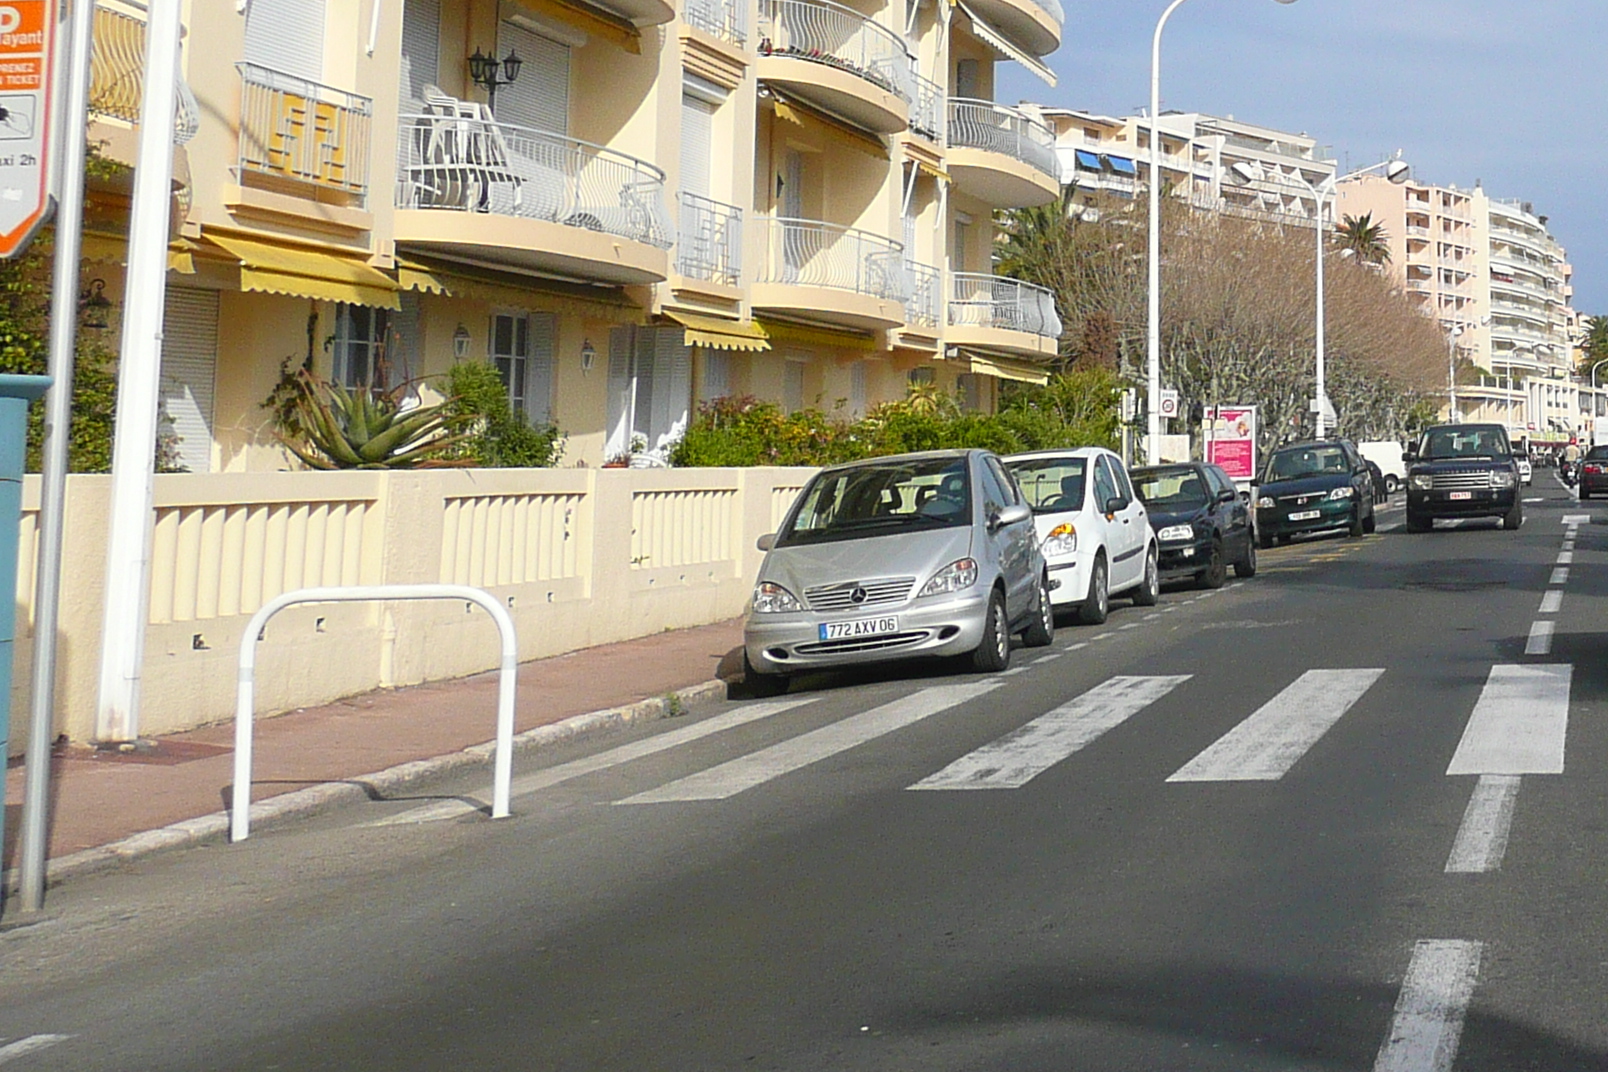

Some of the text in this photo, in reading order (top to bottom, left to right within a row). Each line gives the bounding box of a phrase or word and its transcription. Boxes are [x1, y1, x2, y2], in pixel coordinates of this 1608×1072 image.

[0, 29, 43, 48] ayant
[0, 63, 35, 73] RENEZ
[20, 153, 37, 166] 2h
[829, 618, 895, 637] 772 AXV 06
